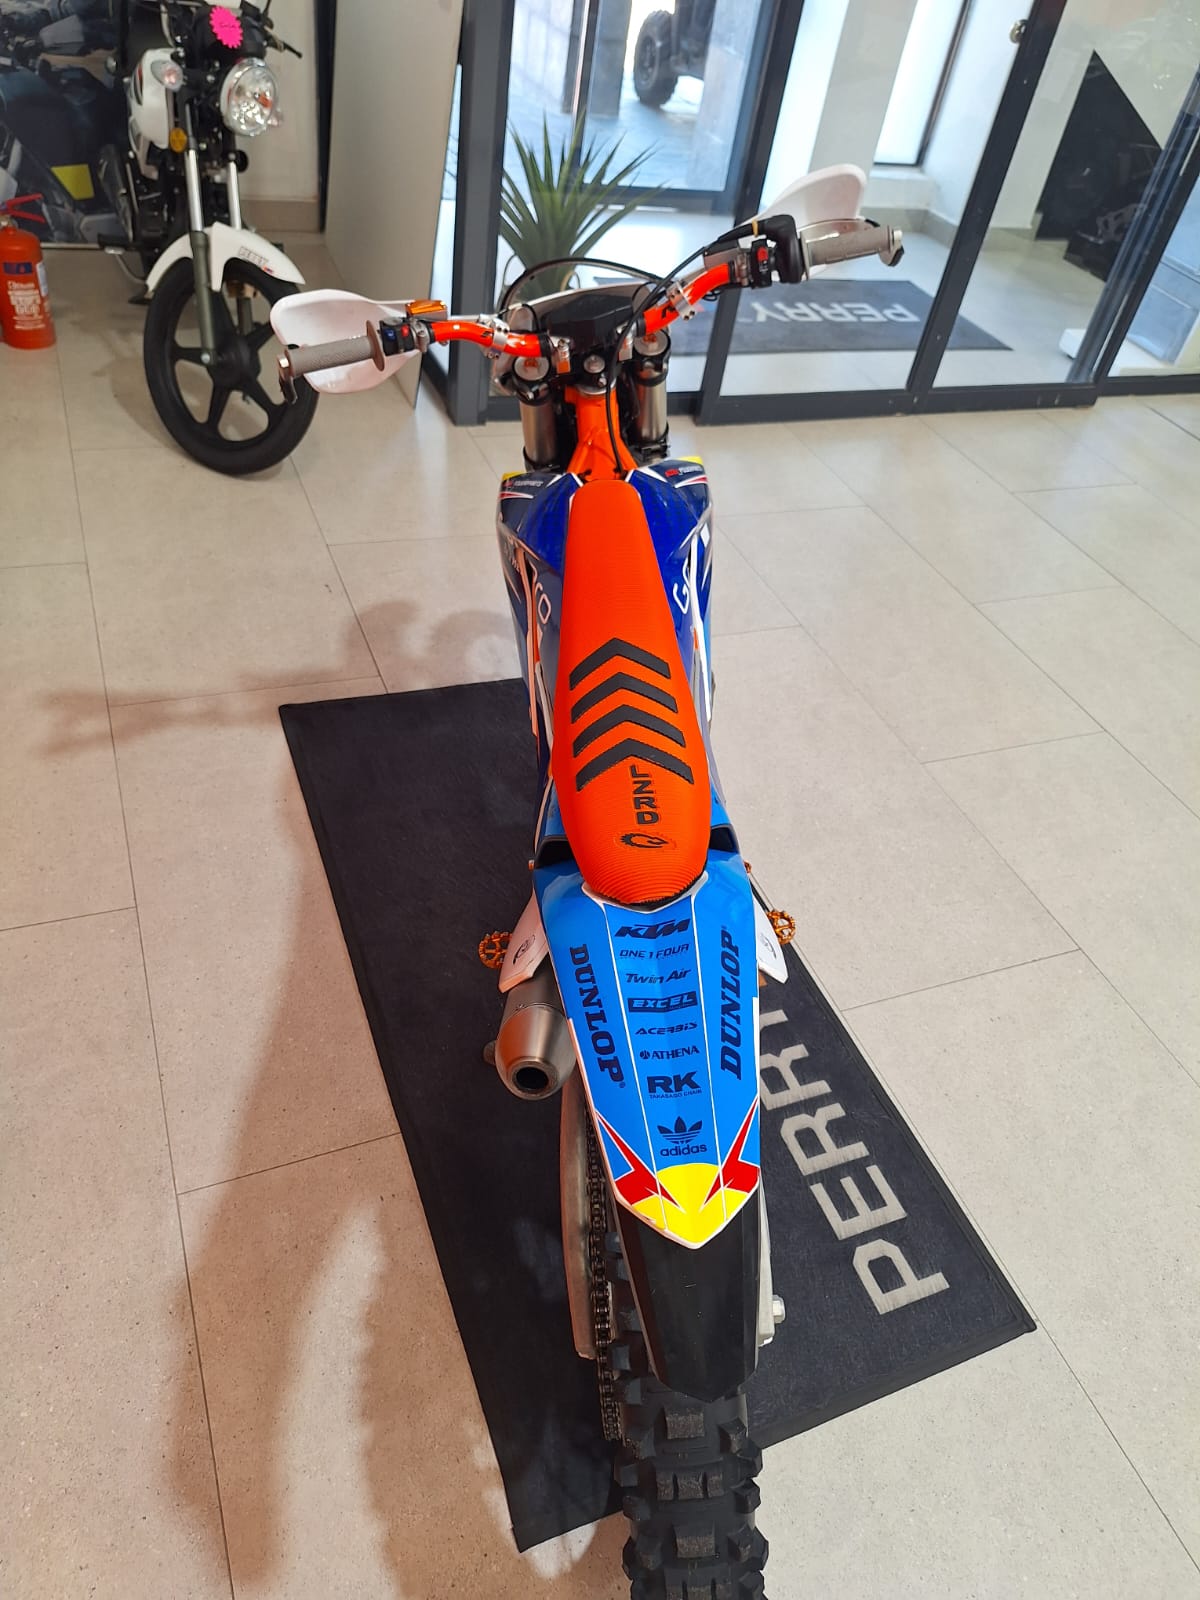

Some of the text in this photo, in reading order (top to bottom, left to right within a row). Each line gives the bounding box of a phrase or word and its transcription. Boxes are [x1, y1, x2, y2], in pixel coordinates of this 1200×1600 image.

[751, 302, 921, 322] PERRY
[630, 764, 660, 825] LZRD
[614, 918, 691, 940] KTM
[619, 949, 647, 959] ONE
[655, 943, 690, 959] FOUR
[625, 968, 692, 984] Twin Air
[631, 993, 696, 1009] EXCEL
[720, 929, 742, 1081] DUNLOP
[569, 944, 625, 1083] DUNLOP
[651, 1045, 700, 1060] ATHENA
[646, 1071, 701, 1094] RK
[660, 1144, 708, 1157] adidas
